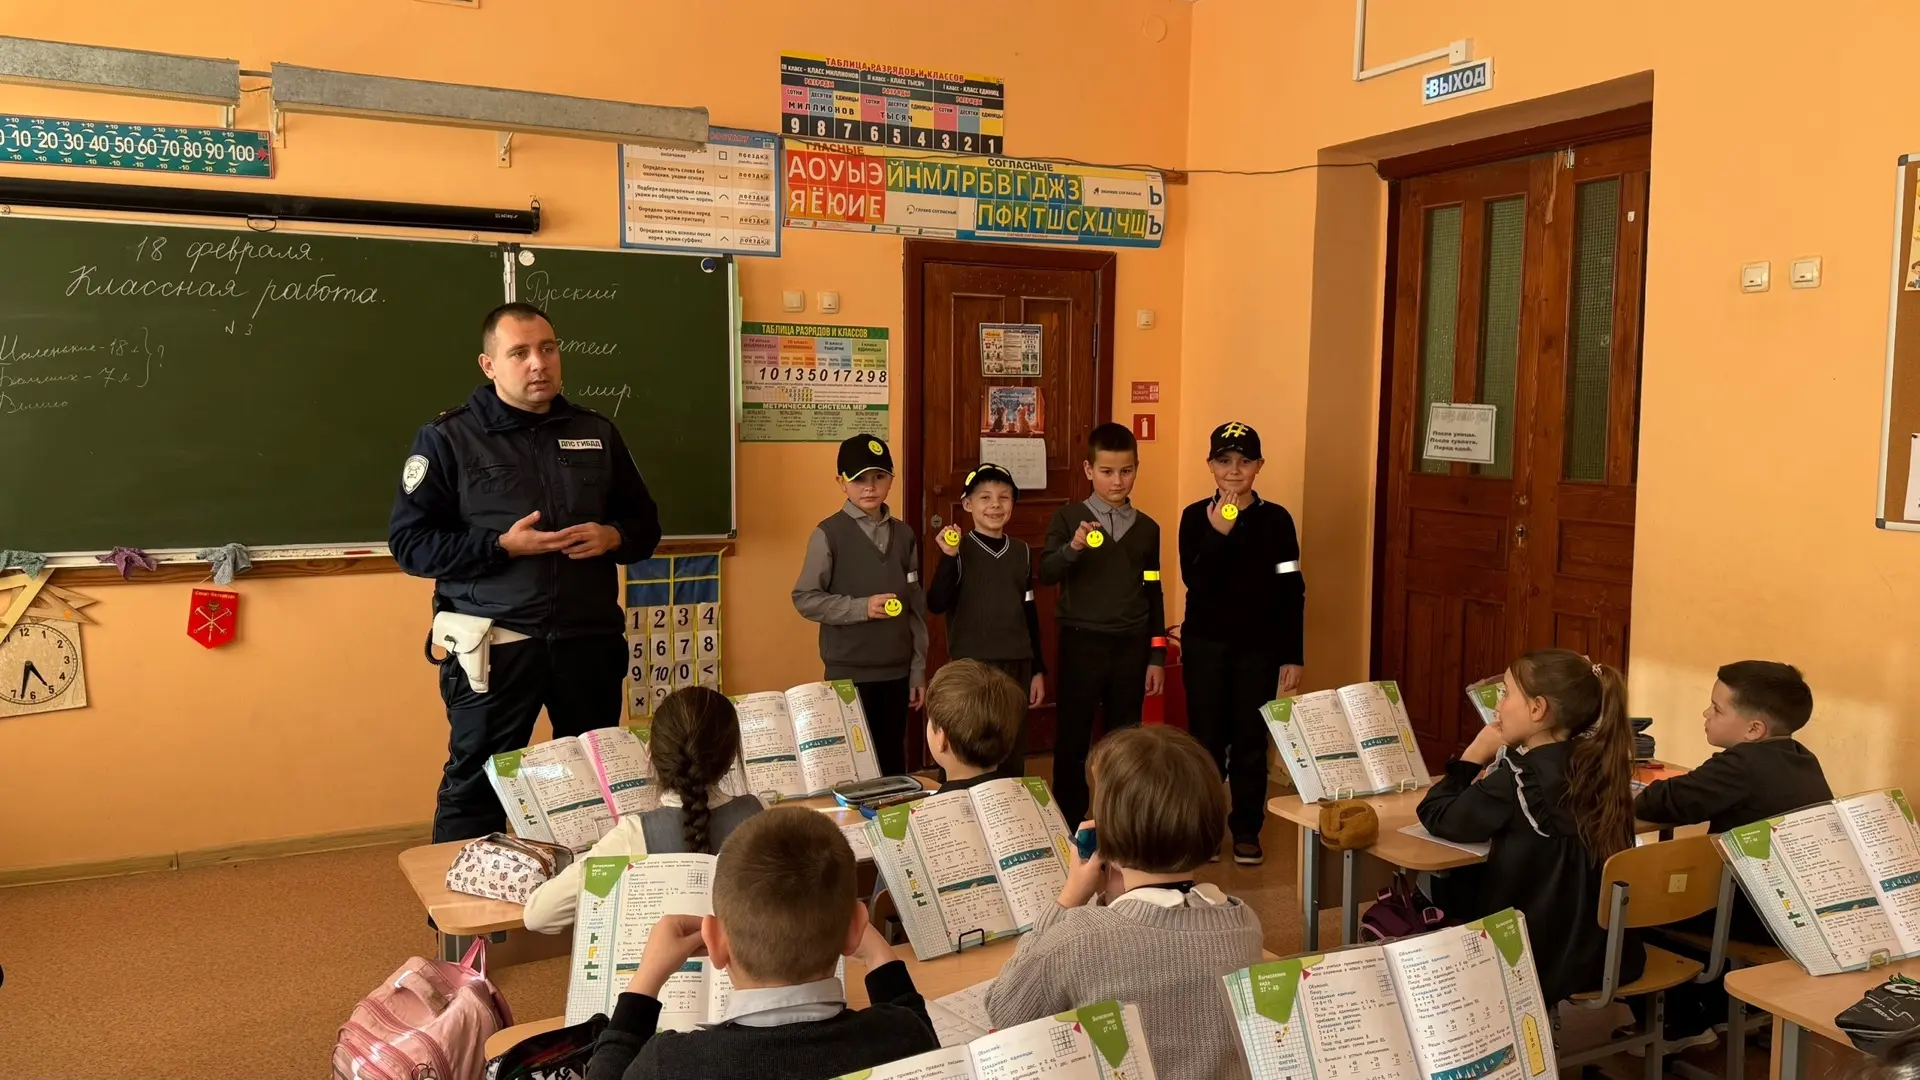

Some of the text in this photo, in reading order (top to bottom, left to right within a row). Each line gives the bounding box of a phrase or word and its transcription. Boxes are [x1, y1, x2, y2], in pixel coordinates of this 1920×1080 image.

[807, 67, 825, 75] КЛАСС
[825, 69, 859, 80] МИЛЛИОНОВ
[825, 57, 964, 83] ТАБЛИЦА РАЗРЯДОВ И КЛАССОВ
[804, 78, 835, 88] РАЗРЯДЫ
[871, 75, 886, 83] класс
[890, 77, 907, 85] КЛАСС
[908, 79, 925, 87] ТЫСЯЧ
[1429, 66, 1485, 97] ВЫХОД
[787, 88, 803, 96] СОТНИ
[811, 92, 832, 100] ДЕСЯТКИ
[882, 87, 911, 97] РАЗРЯДЫ
[963, 86, 978, 94] КЛАСС
[979, 88, 1000, 97] ЕДИНИЦ
[835, 94, 860, 103] ЕДИНИЦЫ
[956, 96, 983, 106] РАЗРЯДЫ
[887, 101, 908, 109] ДЕСЯТКИ
[911, 103, 933, 111] ЕДИНИЦЫ
[938, 106, 953, 114] СОТНИ
[959, 109, 979, 117] ДЕСЯТКИ
[981, 111, 1003, 119] ЕДИНИЦЫ
[791, 117, 995, 153] 9 8 7 6 5 4 3 2 1
[11, 130, 254, 162] 10 20 30 40 50 60 70 80 90 100
[805, 143, 864, 155] ГЛАСНЫЕ
[988, 158, 1054, 172] СОГЛАСНЫЕ
[137, 236, 164, 261] 18
[65, 265, 386, 320] Классная работа.
[525, 271, 621, 313] Русский
[762, 324, 868, 338] ТАБЛИЦА РАЗРЯДОВ И КЛАССОВ
[762, 402, 817, 410] МЕТРИЧЕСКАЯ
[817, 403, 851, 411] СИСТЕМА
[576, 440, 602, 448] ГИБДД
[632, 606, 715, 630] 1 2 3 4
[19, 628, 30, 637] 12
[42, 630, 47, 638] 1
[57, 640, 63, 649] 2
[633, 636, 713, 659] 5 6 7 8
[64, 656, 70, 664] 3
[59, 672, 66, 680] 4
[631, 663, 689, 682] 9 10 0
[11, 690, 36, 699] 7 6
[49, 686, 54, 694] 5
